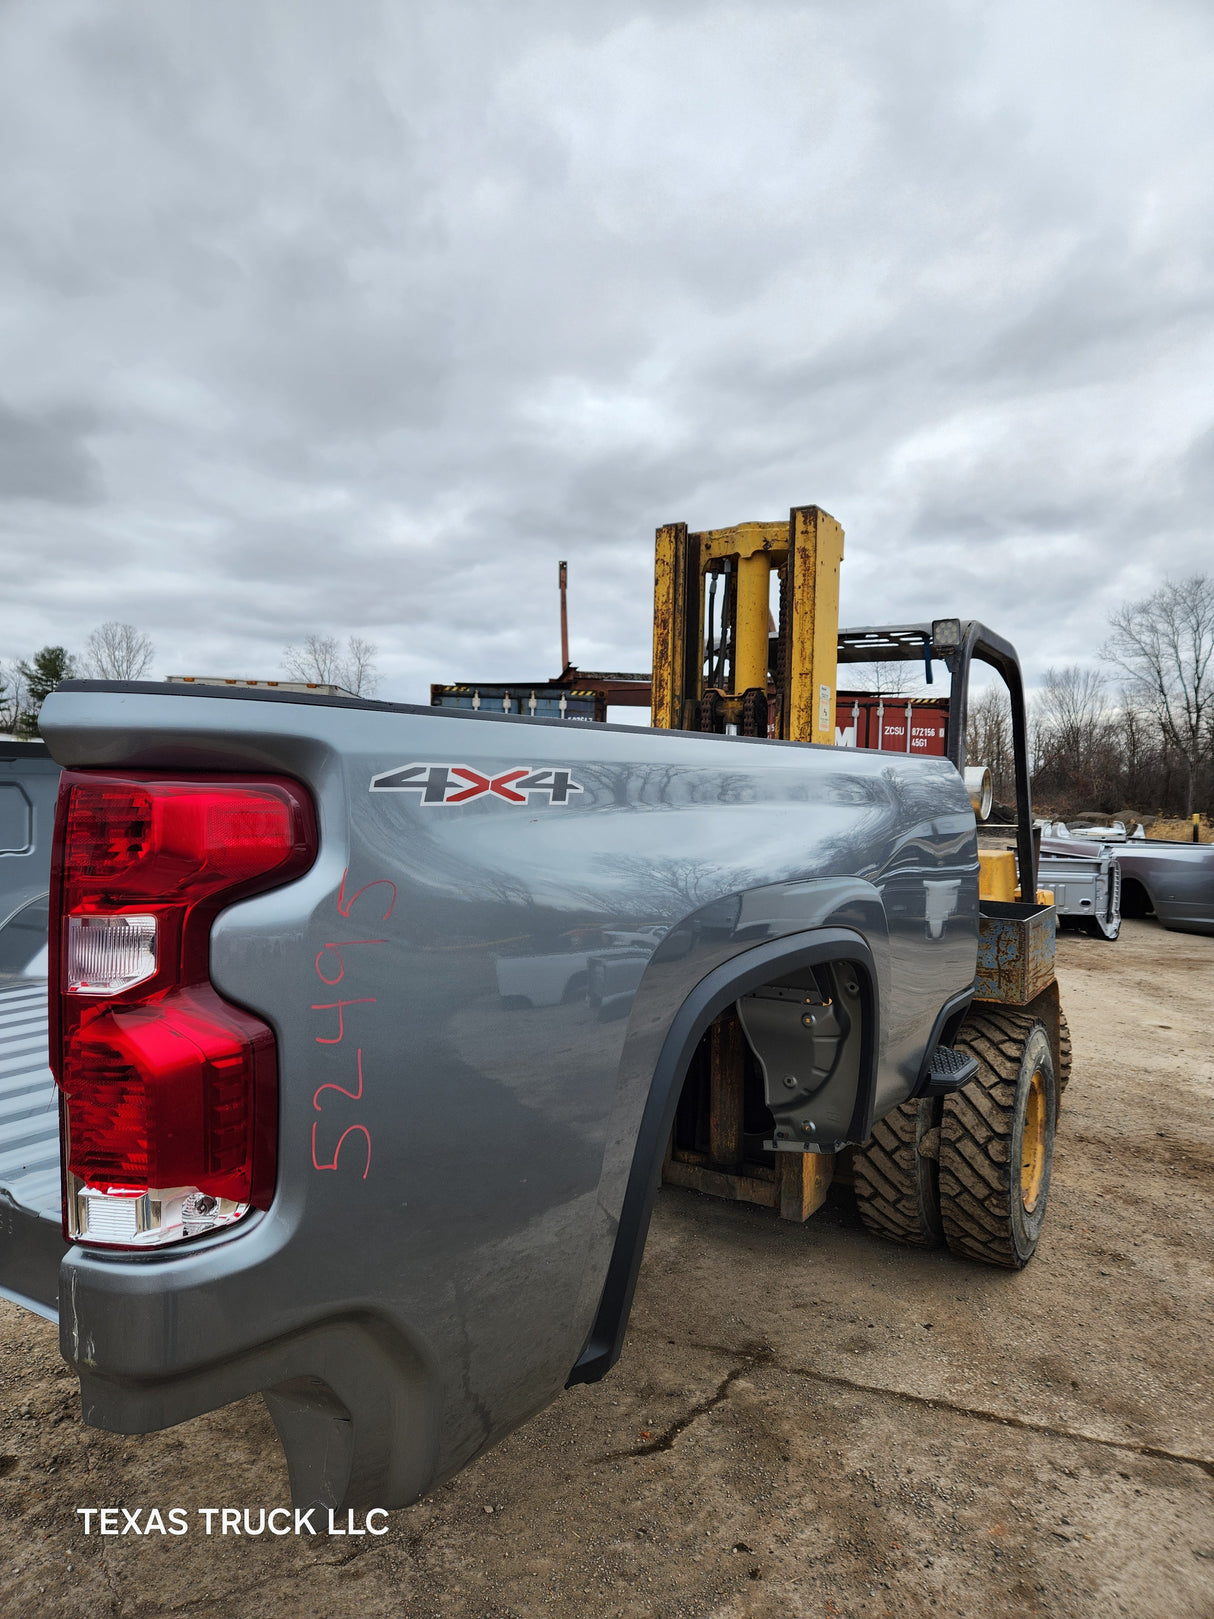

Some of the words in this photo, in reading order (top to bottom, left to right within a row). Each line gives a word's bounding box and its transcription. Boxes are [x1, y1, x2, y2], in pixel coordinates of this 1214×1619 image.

[884, 726, 905, 736] ZCSU
[911, 738, 928, 747] 45G1
[369, 762, 584, 806] 4X4
[311, 867, 397, 1179] 52495
